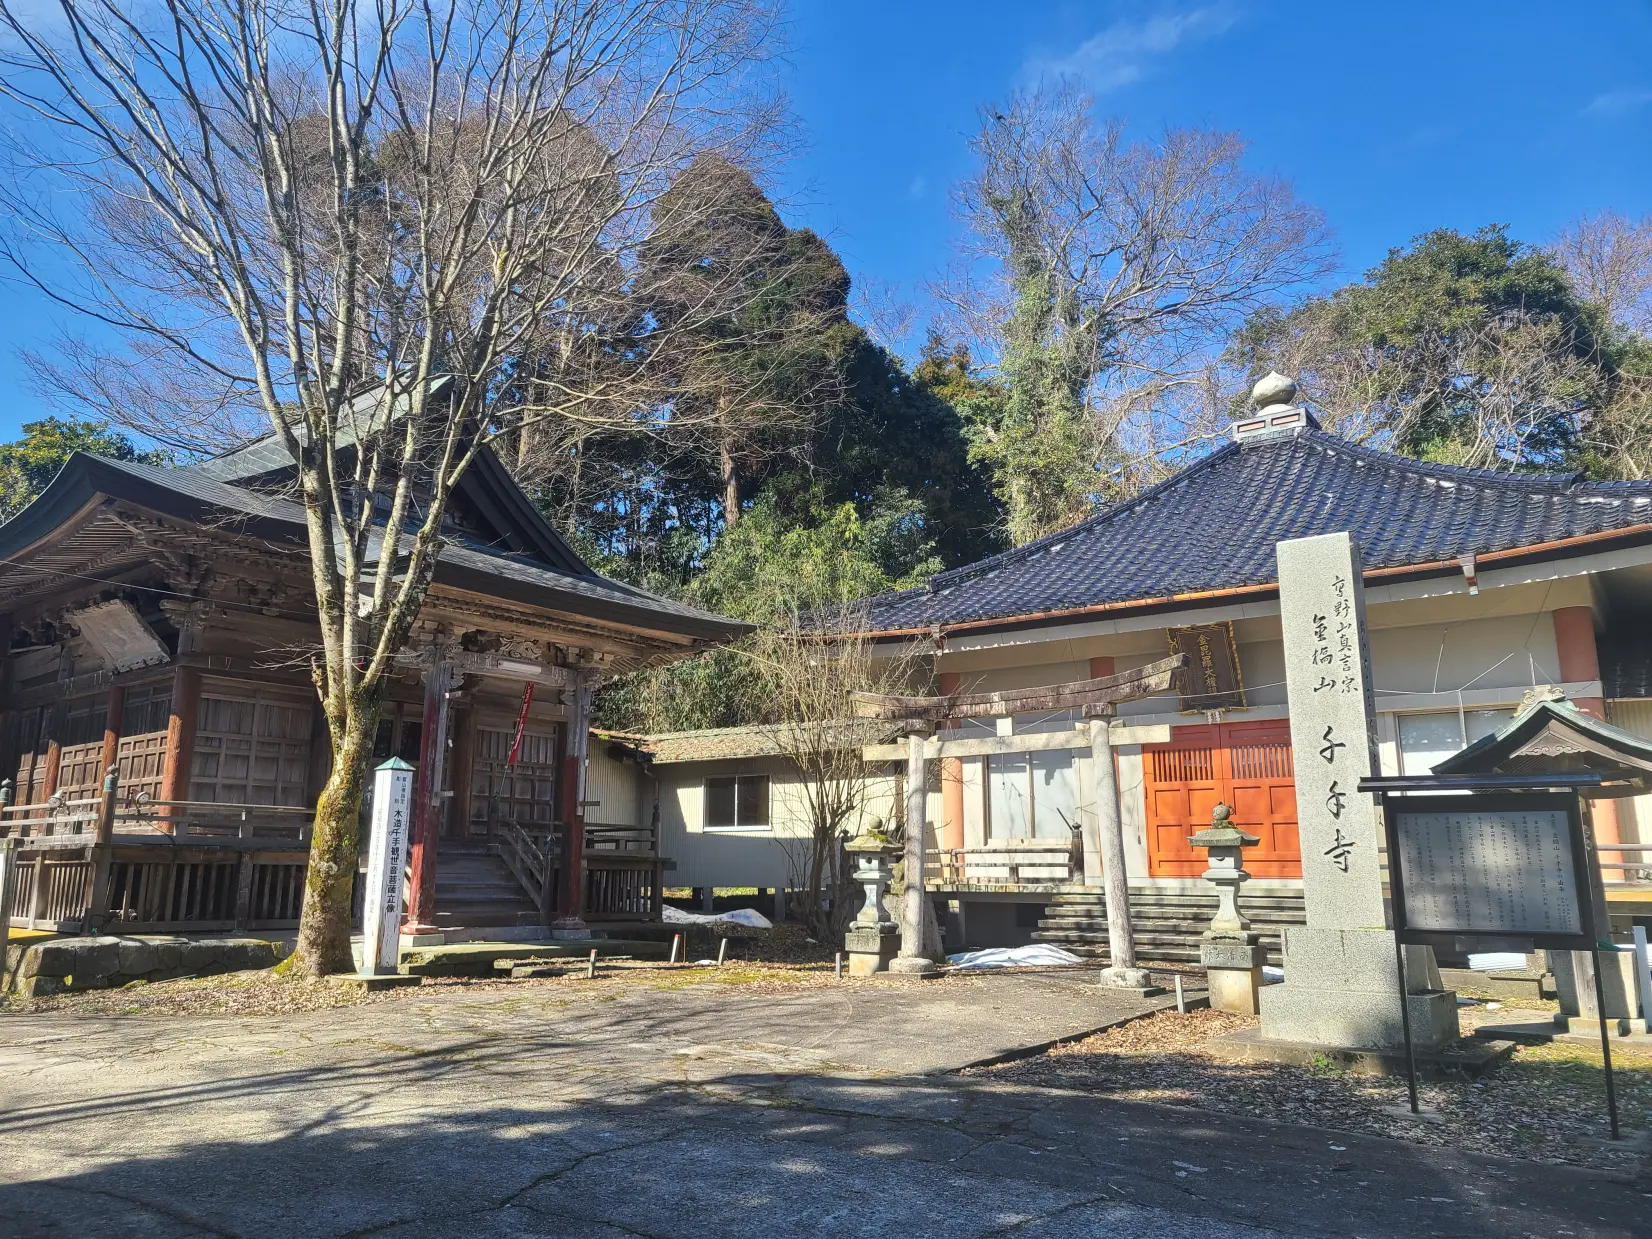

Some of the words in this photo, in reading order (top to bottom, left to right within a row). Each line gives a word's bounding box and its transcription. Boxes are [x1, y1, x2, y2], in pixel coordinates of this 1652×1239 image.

[1331, 575, 1359, 694] 高野山真言宗
[1319, 725, 1357, 874] 千手寺
[386, 809, 403, 913] 木造千手観世音菩薩立像
